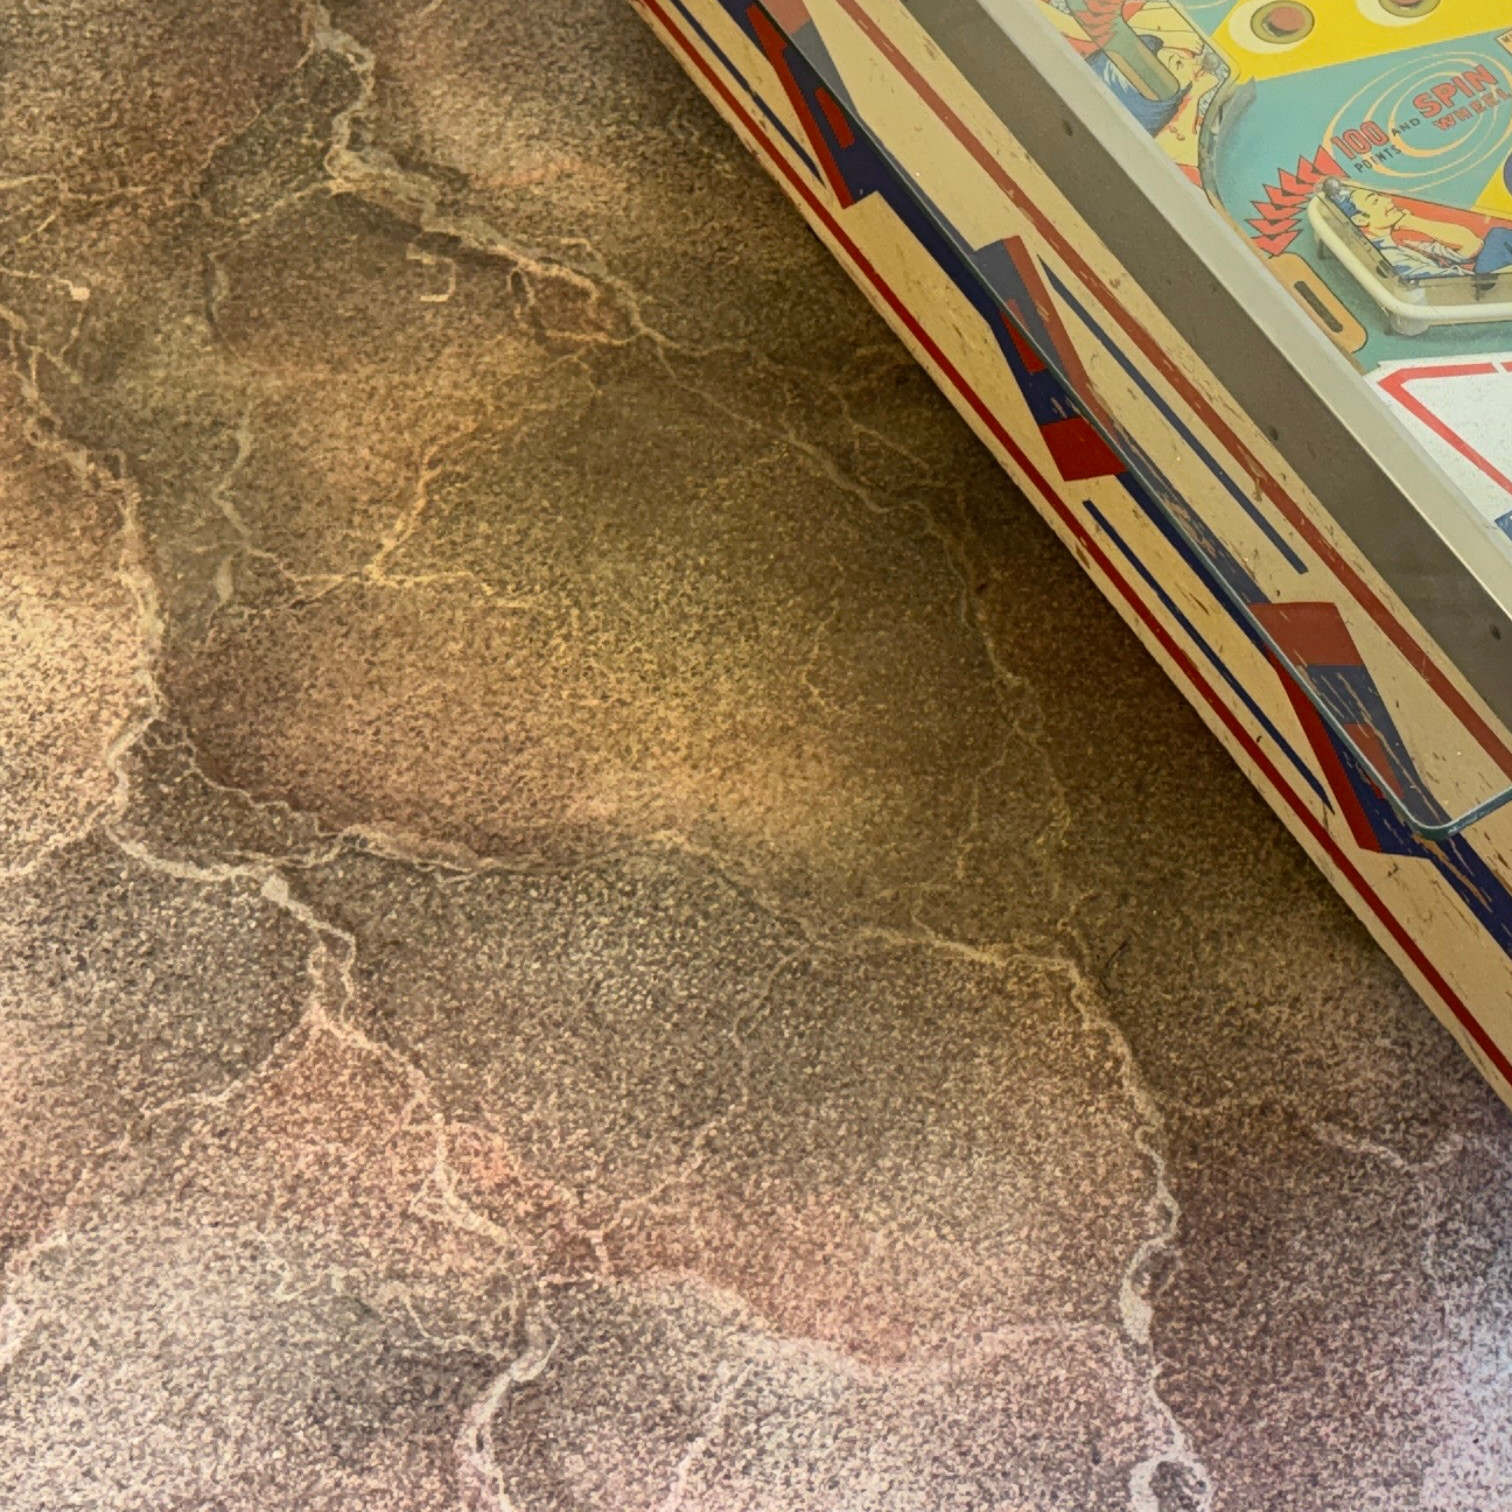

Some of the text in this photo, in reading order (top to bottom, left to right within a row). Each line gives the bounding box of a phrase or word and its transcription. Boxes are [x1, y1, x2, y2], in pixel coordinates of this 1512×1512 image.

[1412, 63, 1499, 119] SPIN
[1431, 88, 1512, 132] WHEEL
[1330, 118, 1421, 162] 100 AND
[1353, 144, 1402, 174] POINTS
